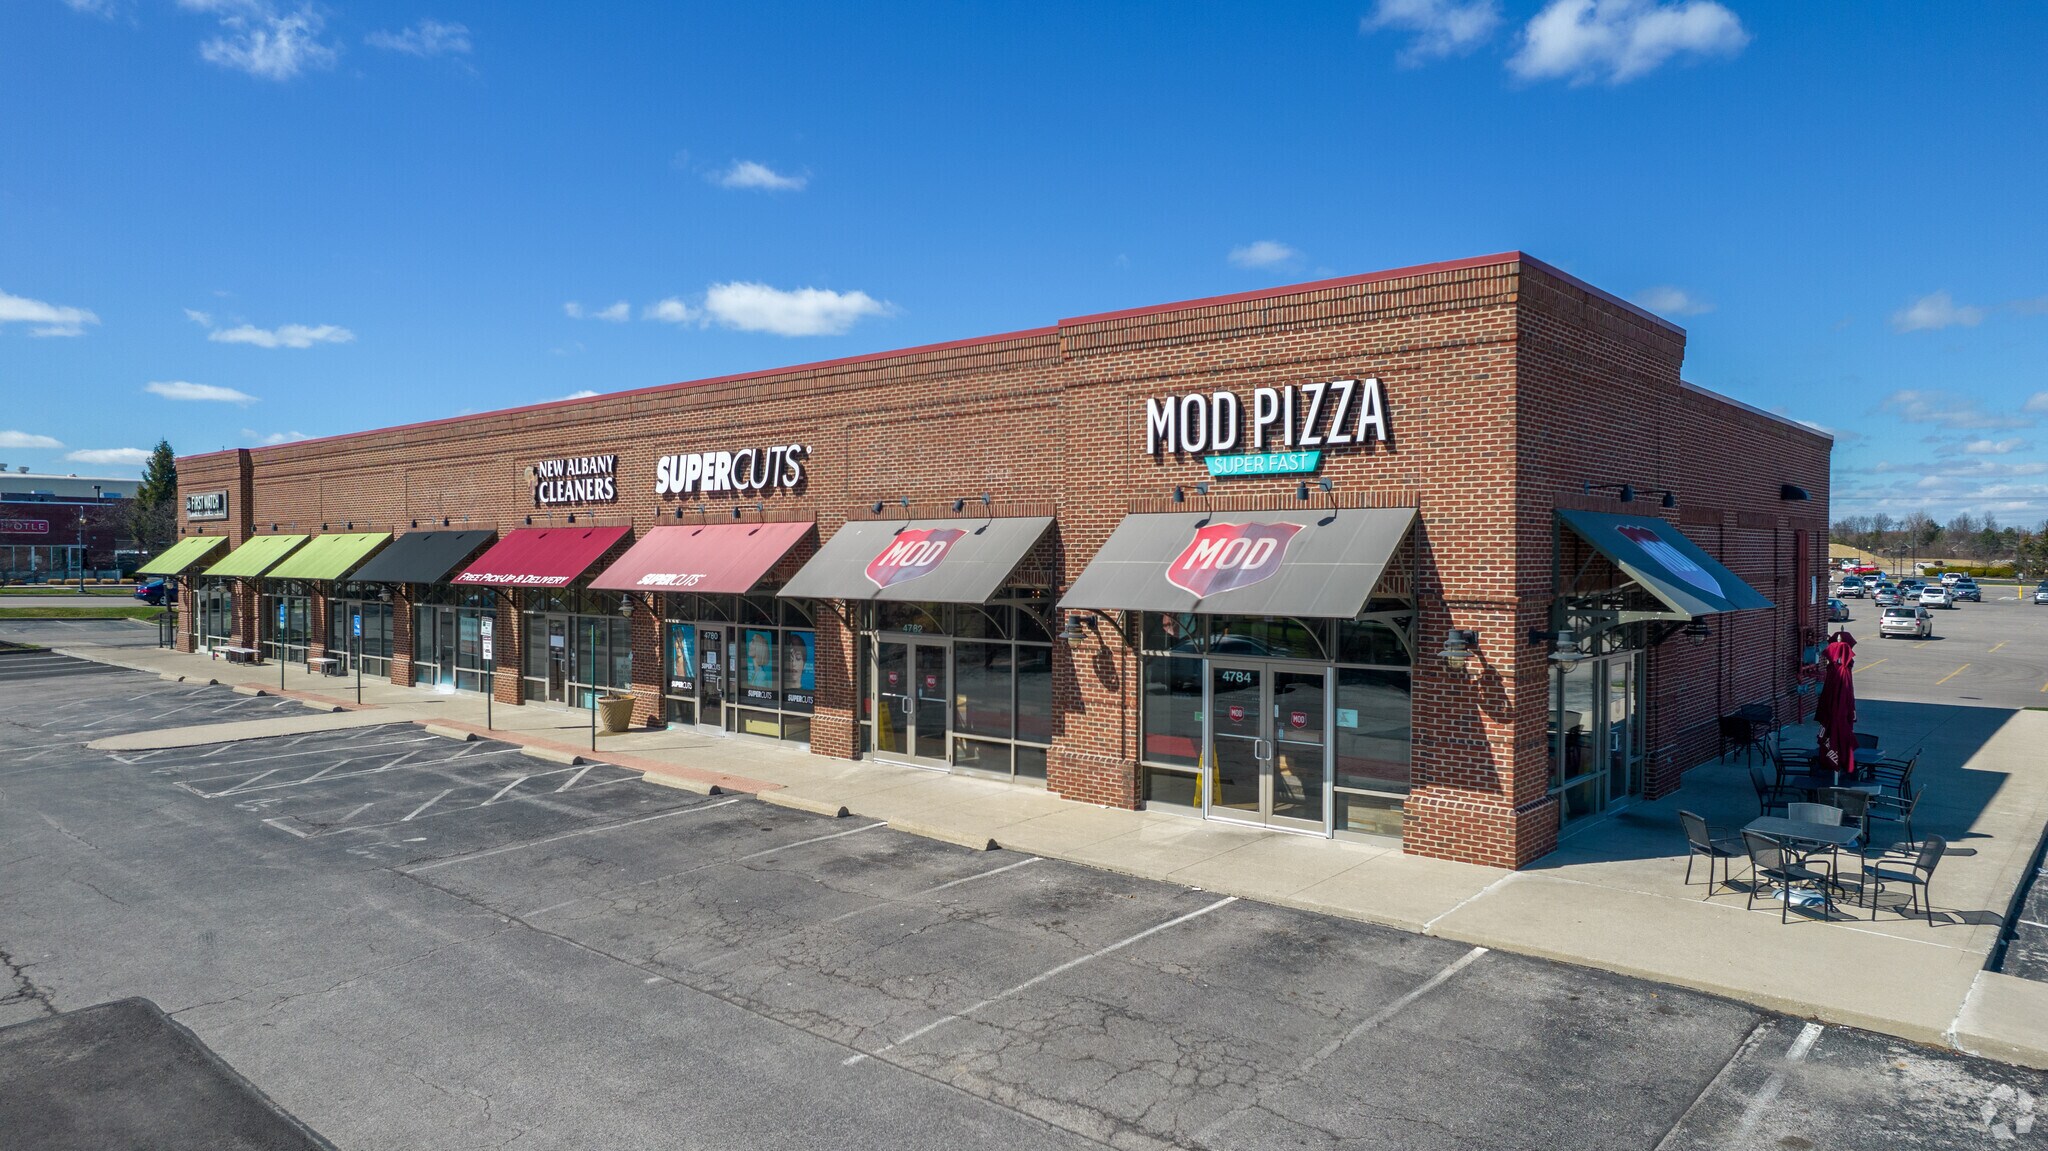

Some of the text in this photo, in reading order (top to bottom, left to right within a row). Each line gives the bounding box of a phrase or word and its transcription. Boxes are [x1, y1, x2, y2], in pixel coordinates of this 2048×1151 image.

[1146, 378, 1387, 454] MOD PIZZA
[539, 455, 615, 478] NEW ALBANY
[1213, 453, 1310, 474] SUPER FAST
[538, 477, 615, 502] CLEANERS
[878, 540, 947, 567] MOD
[1182, 537, 1278, 570] MOD
[458, 572, 482, 582] FREE
[521, 574, 569, 584] DELIVERY
[902, 623, 923, 634] 4782
[704, 631, 719, 640] 4780
[1222, 671, 1251, 683] 4784
[671, 680, 693, 690] SUPERCUTS
[747, 689, 772, 699] SUPERCUTS
[787, 694, 814, 704] SUPERCUTS
[1231, 709, 1243, 717] MOD
[1292, 715, 1305, 724] MOD
